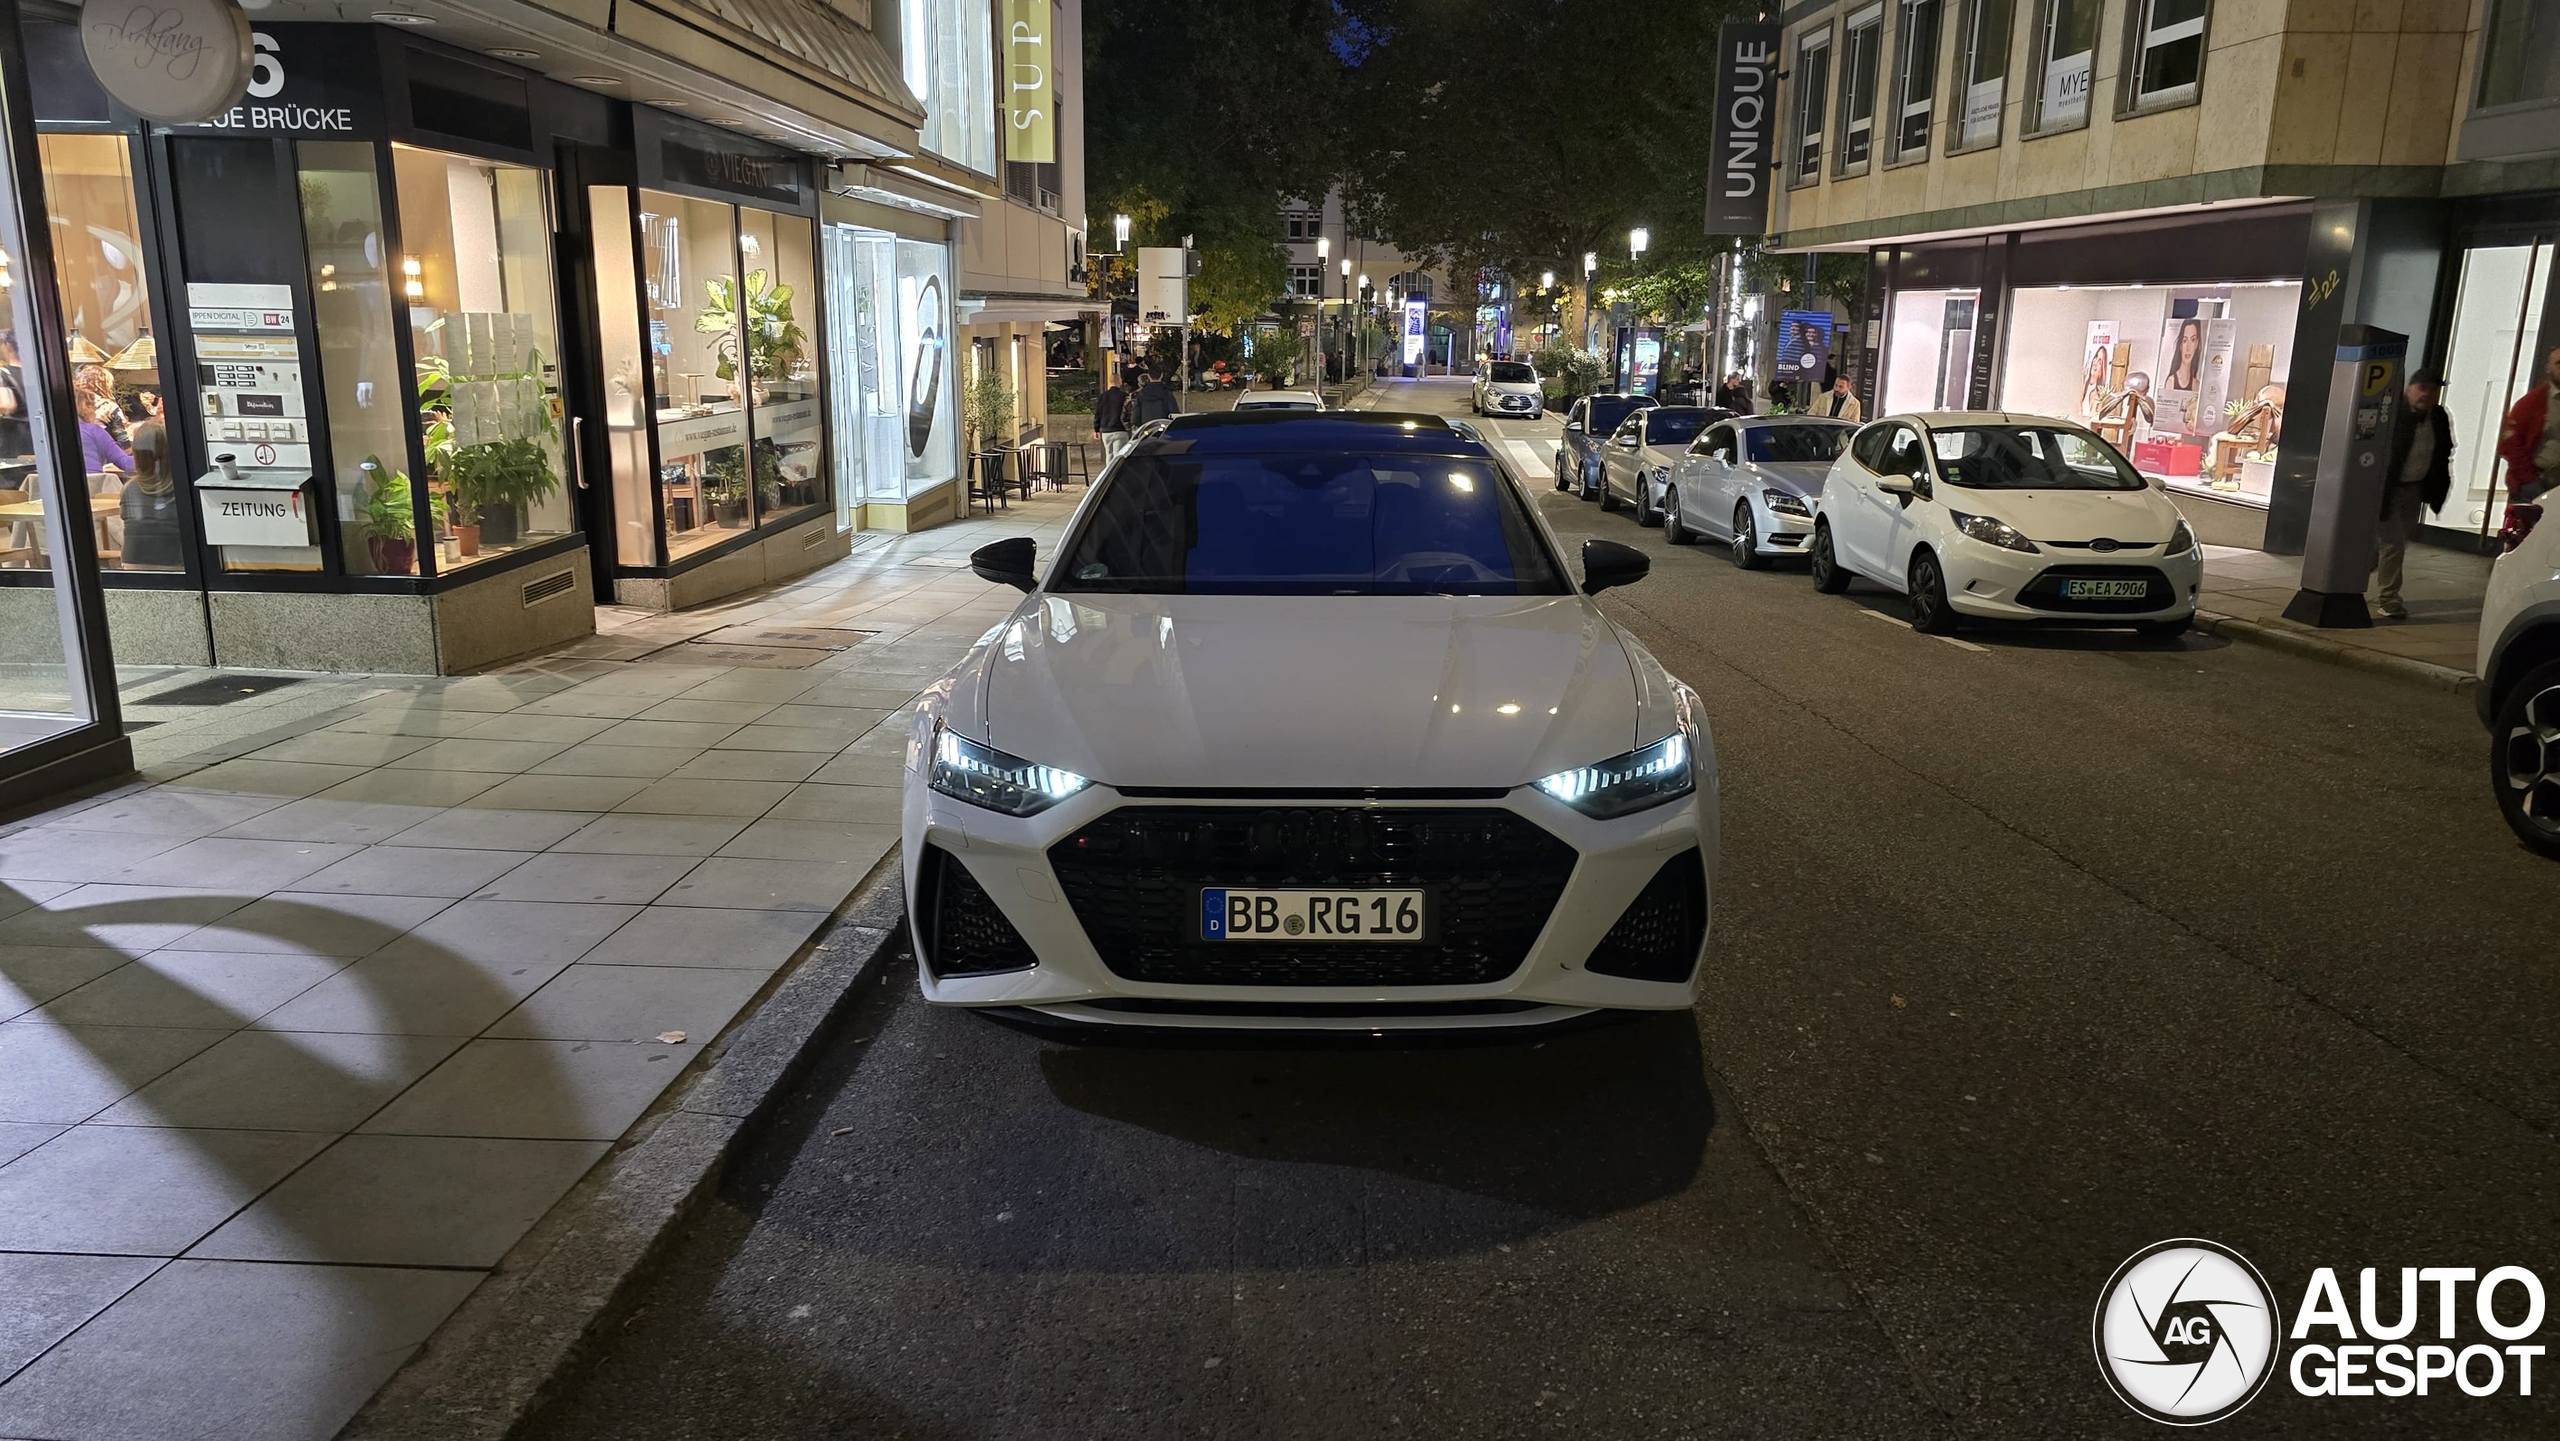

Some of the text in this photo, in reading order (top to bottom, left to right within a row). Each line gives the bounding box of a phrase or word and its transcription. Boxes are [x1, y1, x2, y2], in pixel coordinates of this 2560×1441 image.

[1012, 0, 1044, 130] SUP
[252, 104, 353, 131] BRÜCKE
[1725, 41, 1767, 198] UNIQUE
[721, 151, 768, 188] VIEGAN
[2321, 269, 2340, 300] 22
[193, 312, 213, 320] IPPEN
[213, 313, 240, 321] DIGITAL
[1777, 363, 1800, 371] BLIND
[2367, 365, 2385, 389] P
[221, 502, 286, 517] ZEITUNG
[2069, 581, 2145, 596] ES EA 2906
[1210, 896, 1419, 934] D BB RG 16
